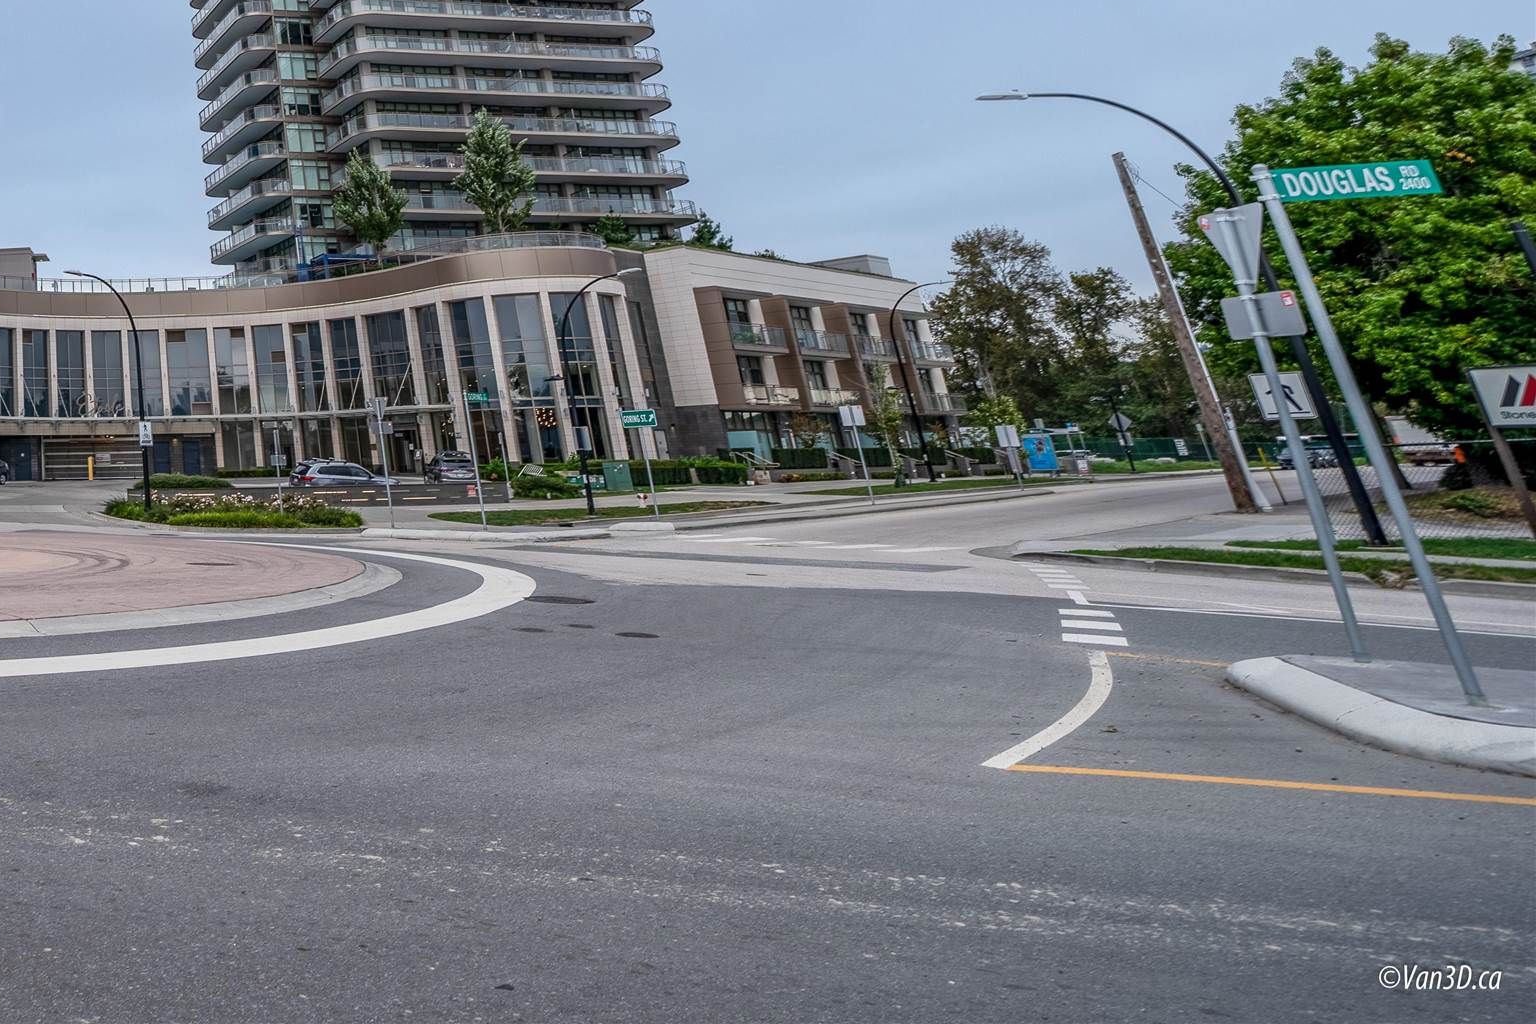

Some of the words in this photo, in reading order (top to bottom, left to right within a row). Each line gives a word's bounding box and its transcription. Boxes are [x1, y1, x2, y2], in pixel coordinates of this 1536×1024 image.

[1281, 166, 1396, 197] DOUGLAS
[1398, 165, 1421, 177] RD
[623, 415, 641, 424] GORING
